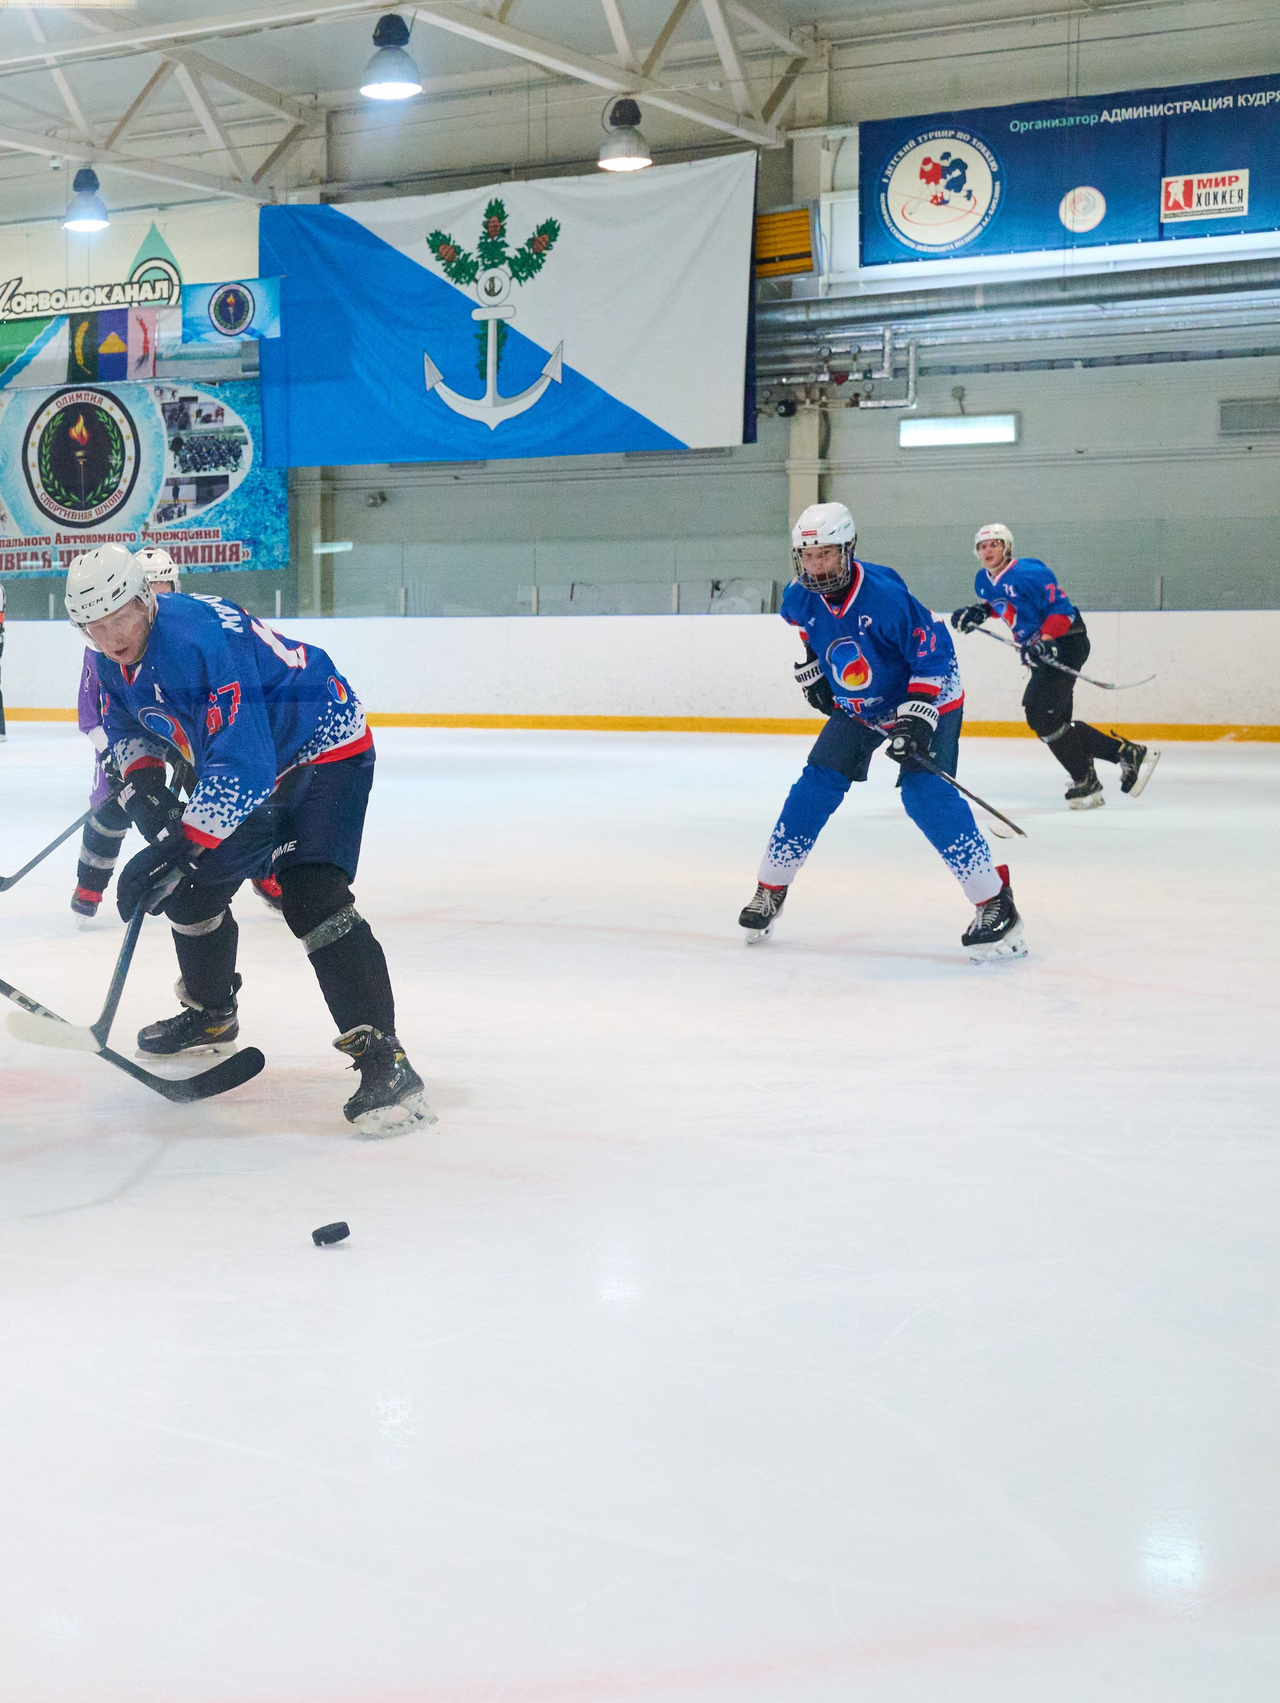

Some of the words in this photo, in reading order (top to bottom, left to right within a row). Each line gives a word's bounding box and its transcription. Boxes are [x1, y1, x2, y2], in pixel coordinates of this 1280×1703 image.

[1009, 114, 1100, 134] Организатор
[1100, 96, 1234, 123] АДМИНИСТРАЦИЯ
[1197, 175, 1240, 190] МИР
[1196, 189, 1244, 208] ХОККЕЯ
[55, 392, 104, 409] ОЛИМПИЯ
[40, 491, 93, 520] СПОРТИВНАЯ
[54, 532, 137, 545] Автономного
[81, 596, 104, 610] CCM
